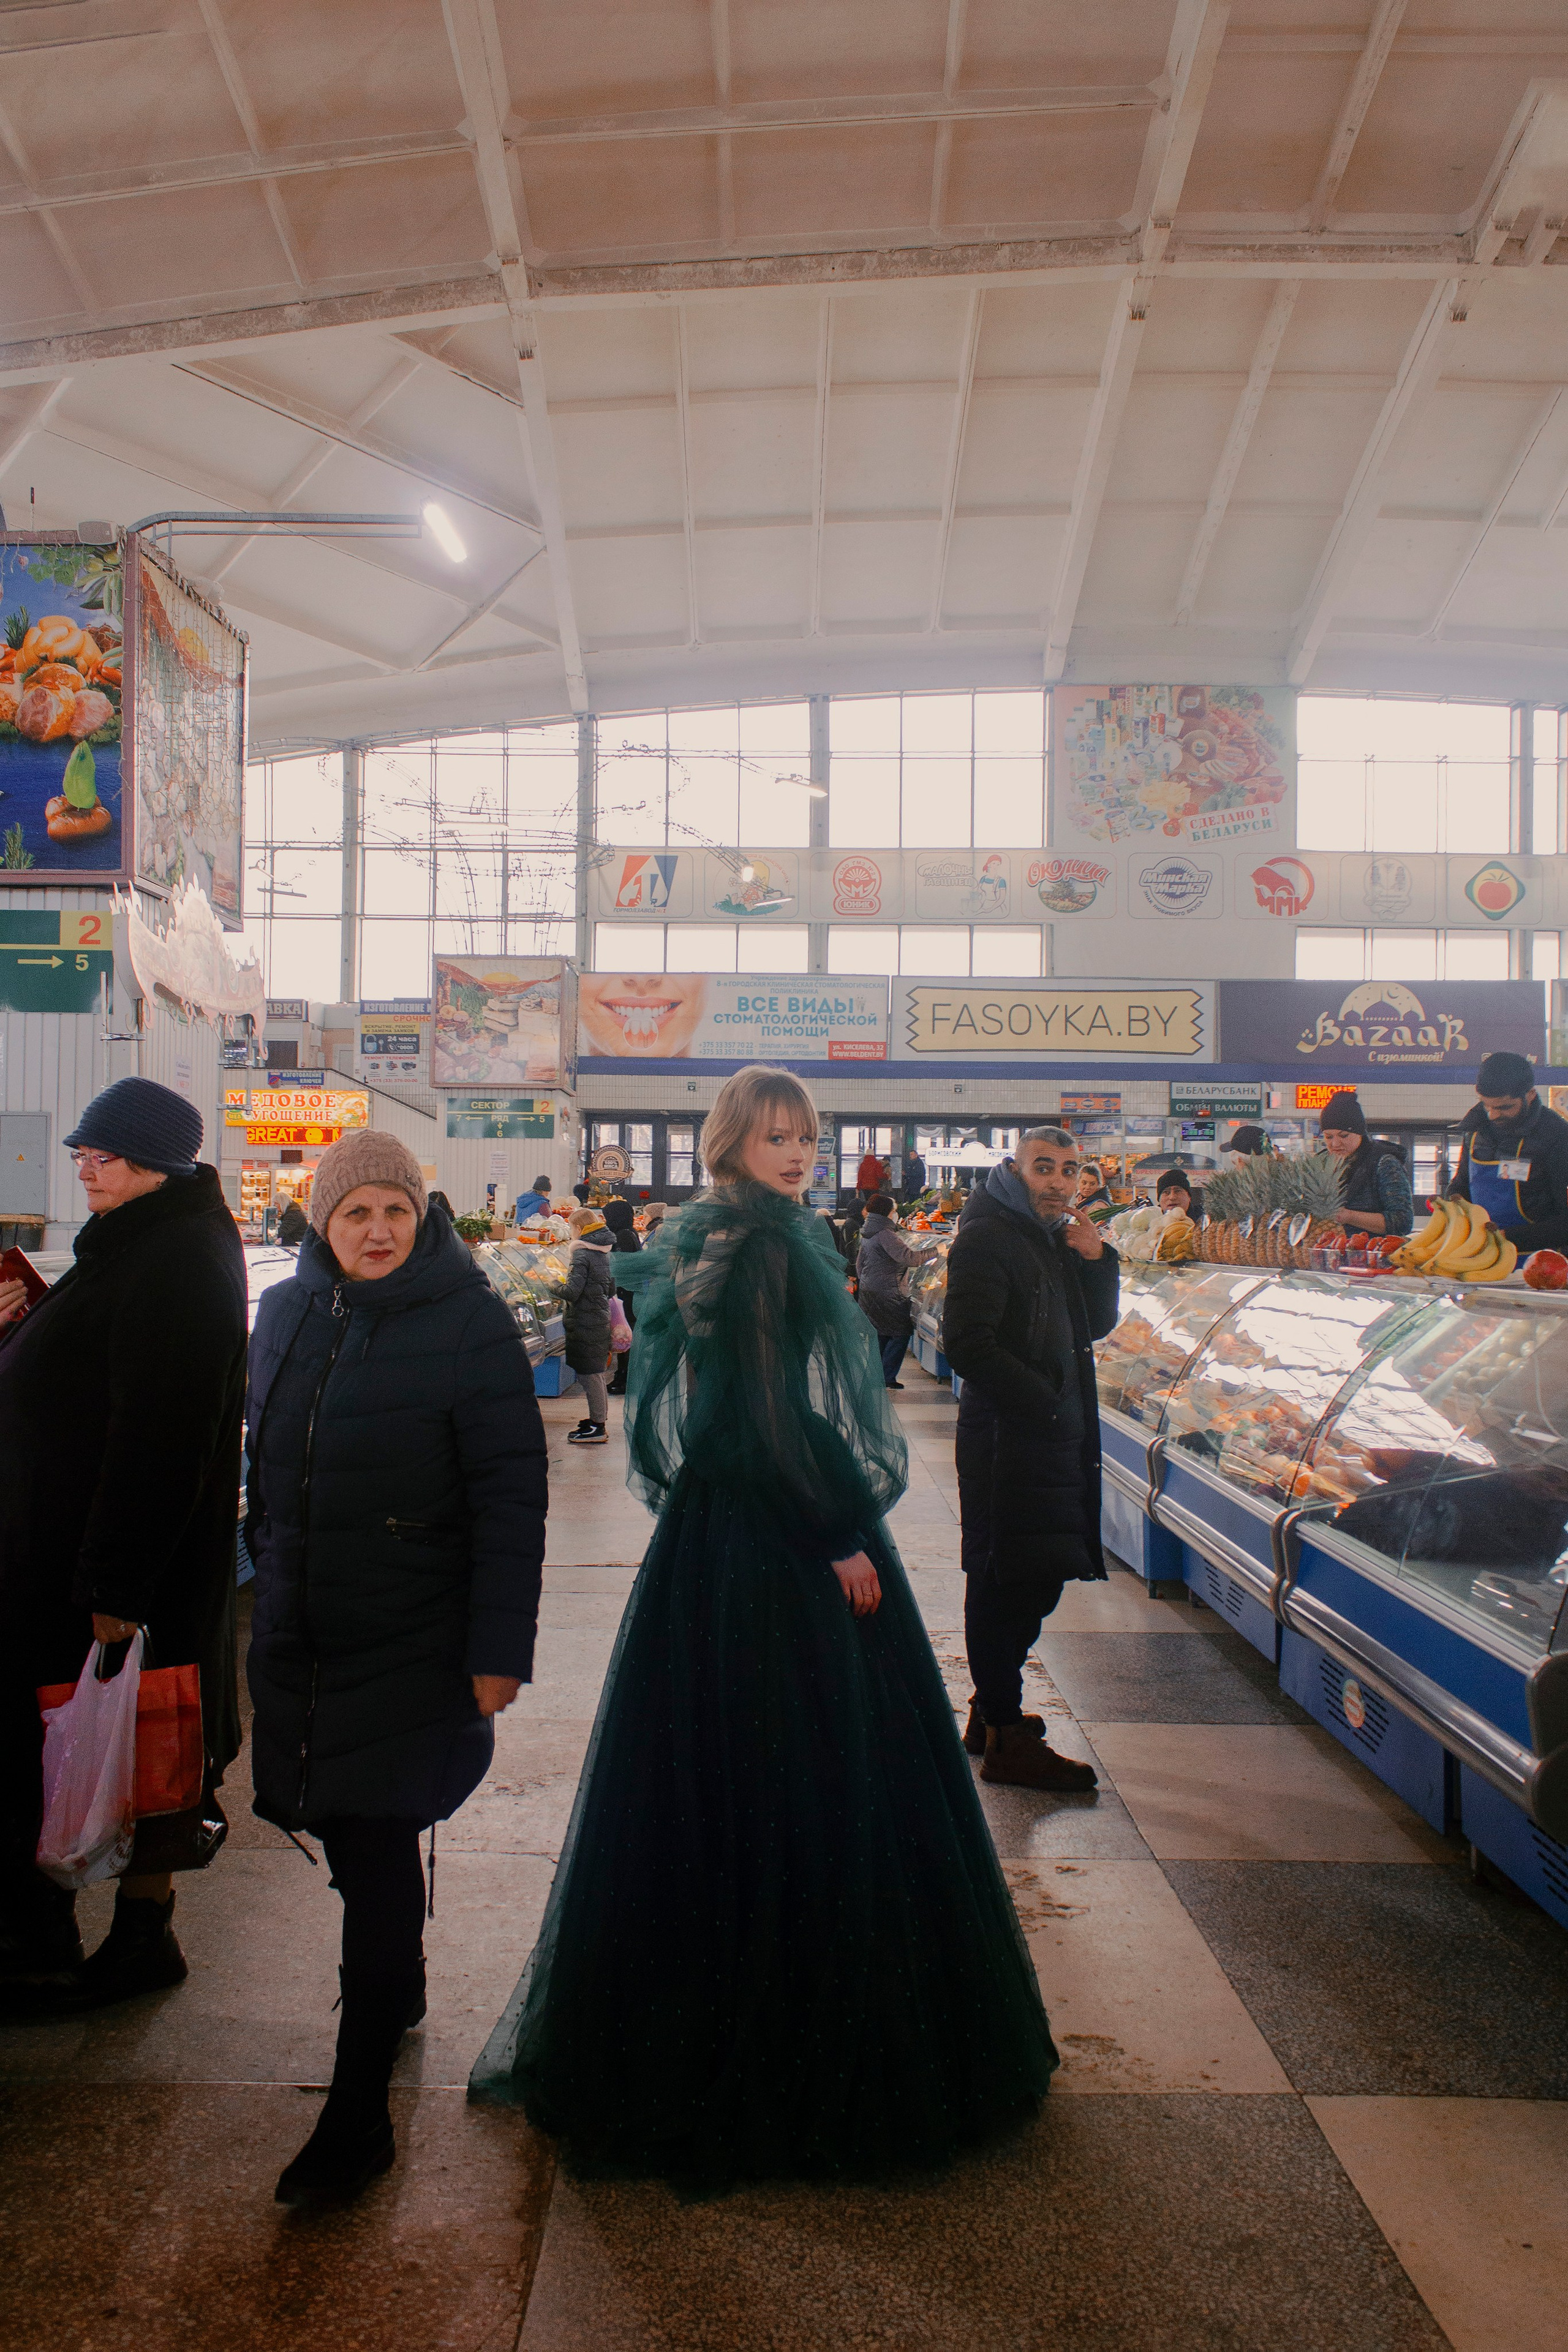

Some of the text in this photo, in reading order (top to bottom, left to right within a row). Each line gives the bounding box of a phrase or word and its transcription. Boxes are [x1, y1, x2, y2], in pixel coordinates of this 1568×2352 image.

[1190, 807, 1270, 829] СДЕЛАНО В
[1192, 818, 1273, 842] БЕЛАРУСИ
[839, 864, 850, 875] ОАО
[923, 862, 973, 876] МАЛОЧНЫ
[1027, 859, 1110, 886] Околица
[923, 877, 973, 887] ГАСЦІНЕЦ
[1142, 871, 1208, 884] Минская
[1155, 881, 1205, 895] Марка
[1152, 903, 1186, 916] ЛЮБИМОГО
[78, 915, 101, 944] 2
[75, 954, 89, 971] 5
[266, 1003, 302, 1015] АВКА
[364, 1003, 424, 1013] ИЗГОТОВЛЕНИЕ
[737, 997, 853, 1014] ВСЕ ВИДЫ
[713, 1012, 877, 1026] СТОМАТОЛОГИЧЕСКОЙ
[931, 1003, 1178, 1038] FASOYKA.BY
[761, 1026, 829, 1038] ПОМОЩИ
[1377, 1050, 1444, 1064] изюминкой!
[1186, 1086, 1257, 1095] БЕЛАРУСБАНК
[1298, 1086, 1357, 1099] РЕМО
[228, 1093, 336, 1109] МЕДОВОЕ
[541, 1101, 549, 1113] 2
[1175, 1103, 1257, 1112] ОБМЕН ВАЛЮТЫ
[1298, 1099, 1330, 1108] ПЛАН
[252, 1110, 333, 1122] УГОЩЕНИЕ
[247, 1128, 298, 1142] GREAT
